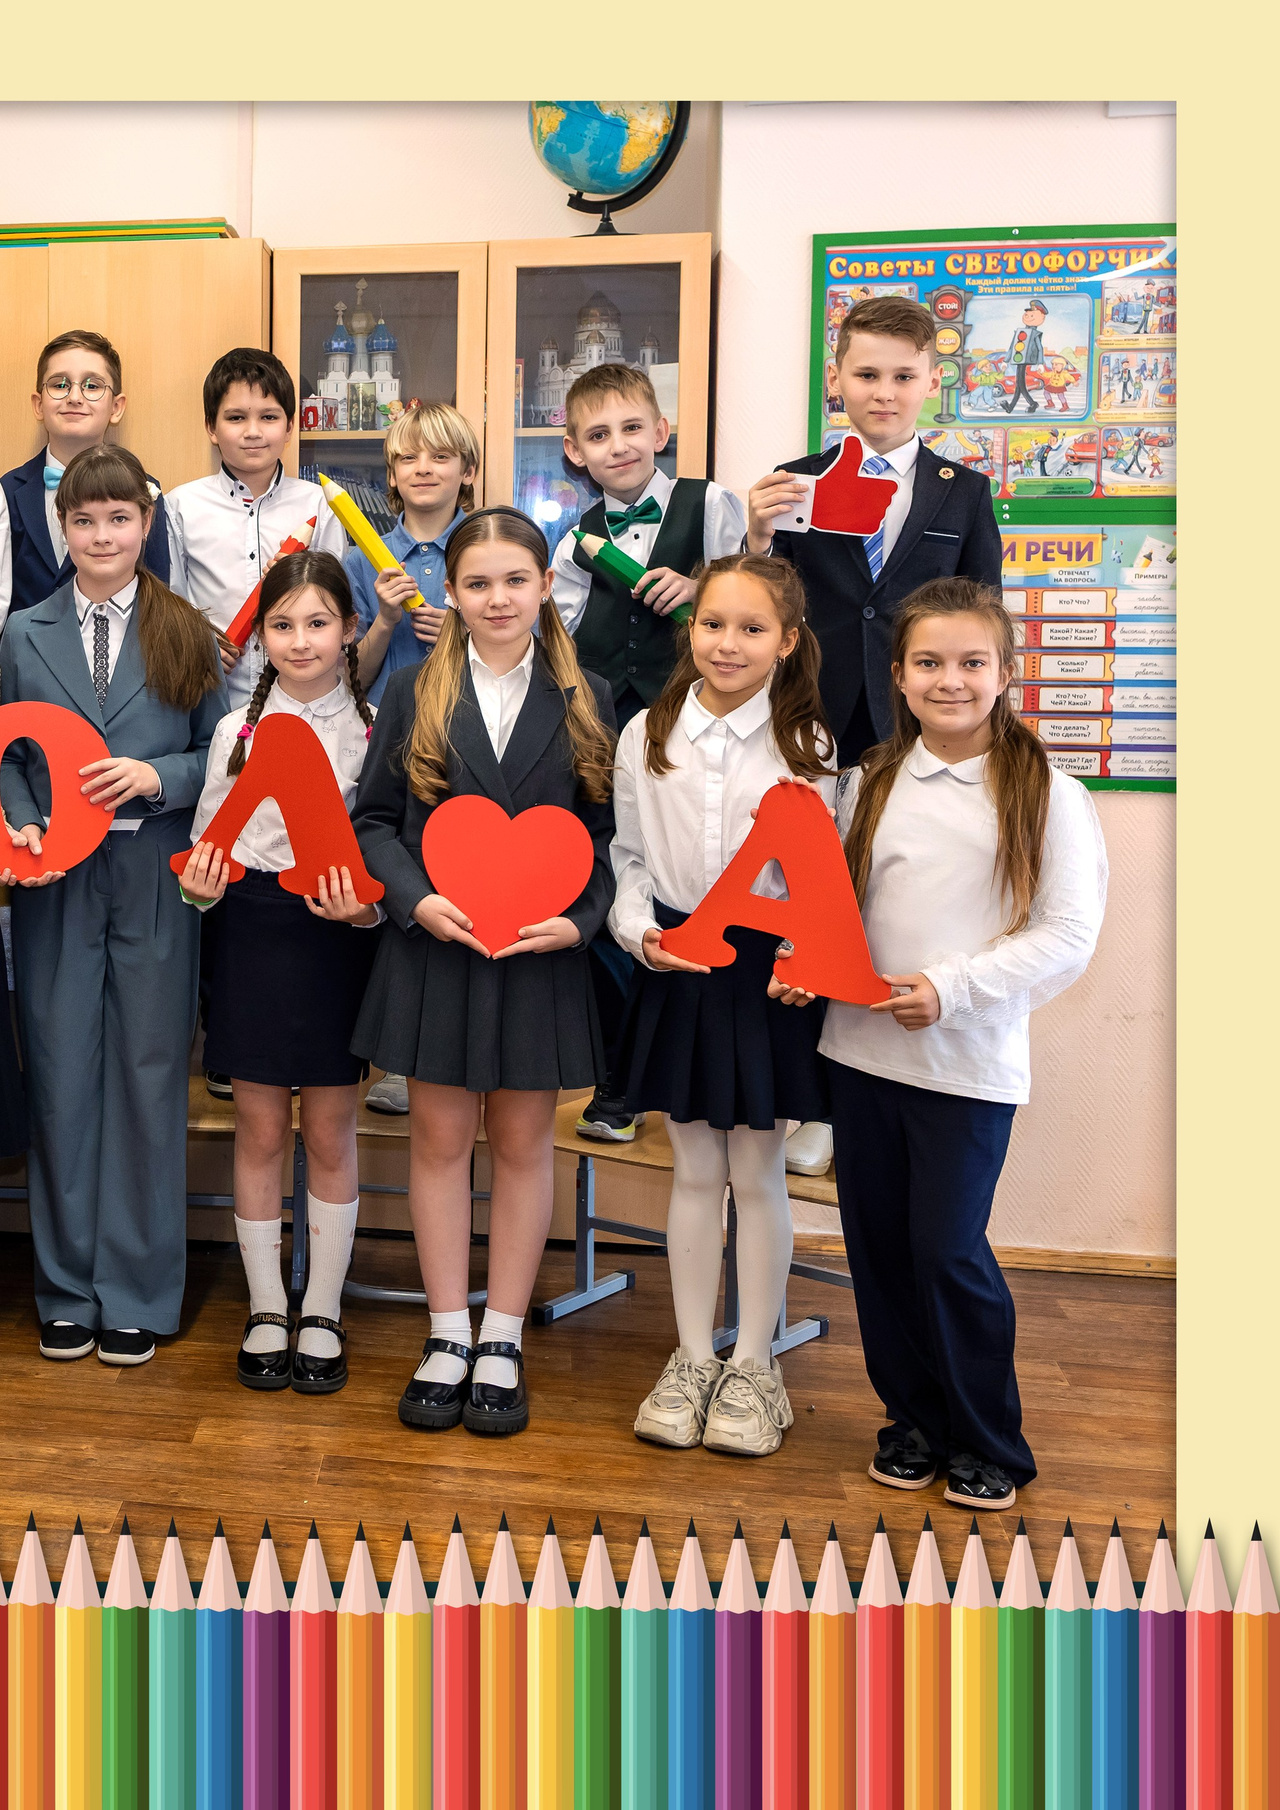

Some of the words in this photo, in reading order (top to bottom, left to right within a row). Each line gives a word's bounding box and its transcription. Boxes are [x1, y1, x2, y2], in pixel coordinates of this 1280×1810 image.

[829, 256, 936, 279] Советы
[945, 247, 1176, 276] СВЕТОФОРЧИК
[965, 277, 1002, 286] Каждый
[1003, 277, 1036, 285] должен
[978, 286, 994, 294] Эти
[995, 286, 1032, 294] правила
[938, 301, 958, 310] СТОЙ!
[938, 337, 956, 345] ЖДИ!
[942, 370, 955, 378] ДИ!
[1025, 541, 1094, 562] РЕЧИ
[660, 781, 893, 1006] А
